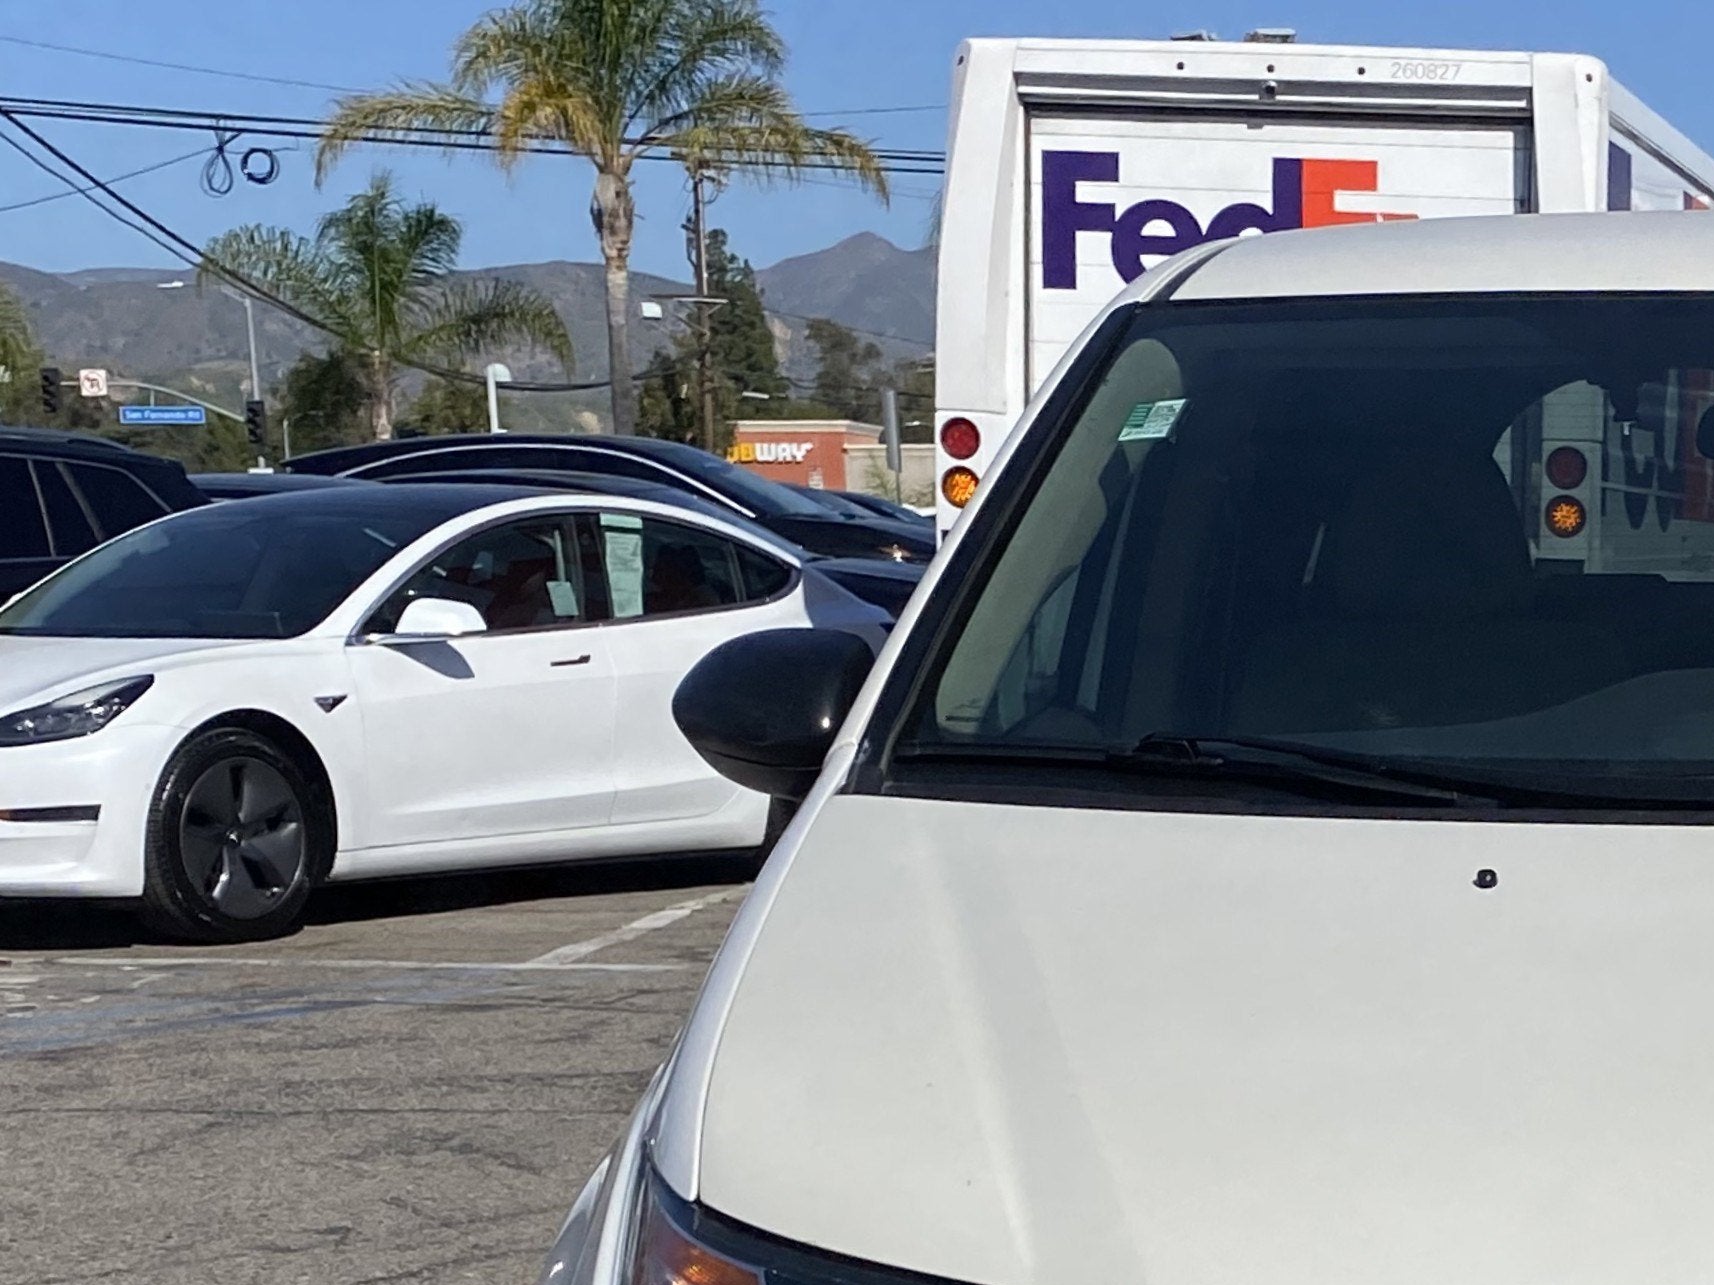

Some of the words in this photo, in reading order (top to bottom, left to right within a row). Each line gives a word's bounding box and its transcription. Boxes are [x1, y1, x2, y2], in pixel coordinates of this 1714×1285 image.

[1391, 61, 1463, 81] 260827
[1041, 150, 1420, 289] FedE
[727, 442, 814, 463] UBWAY
